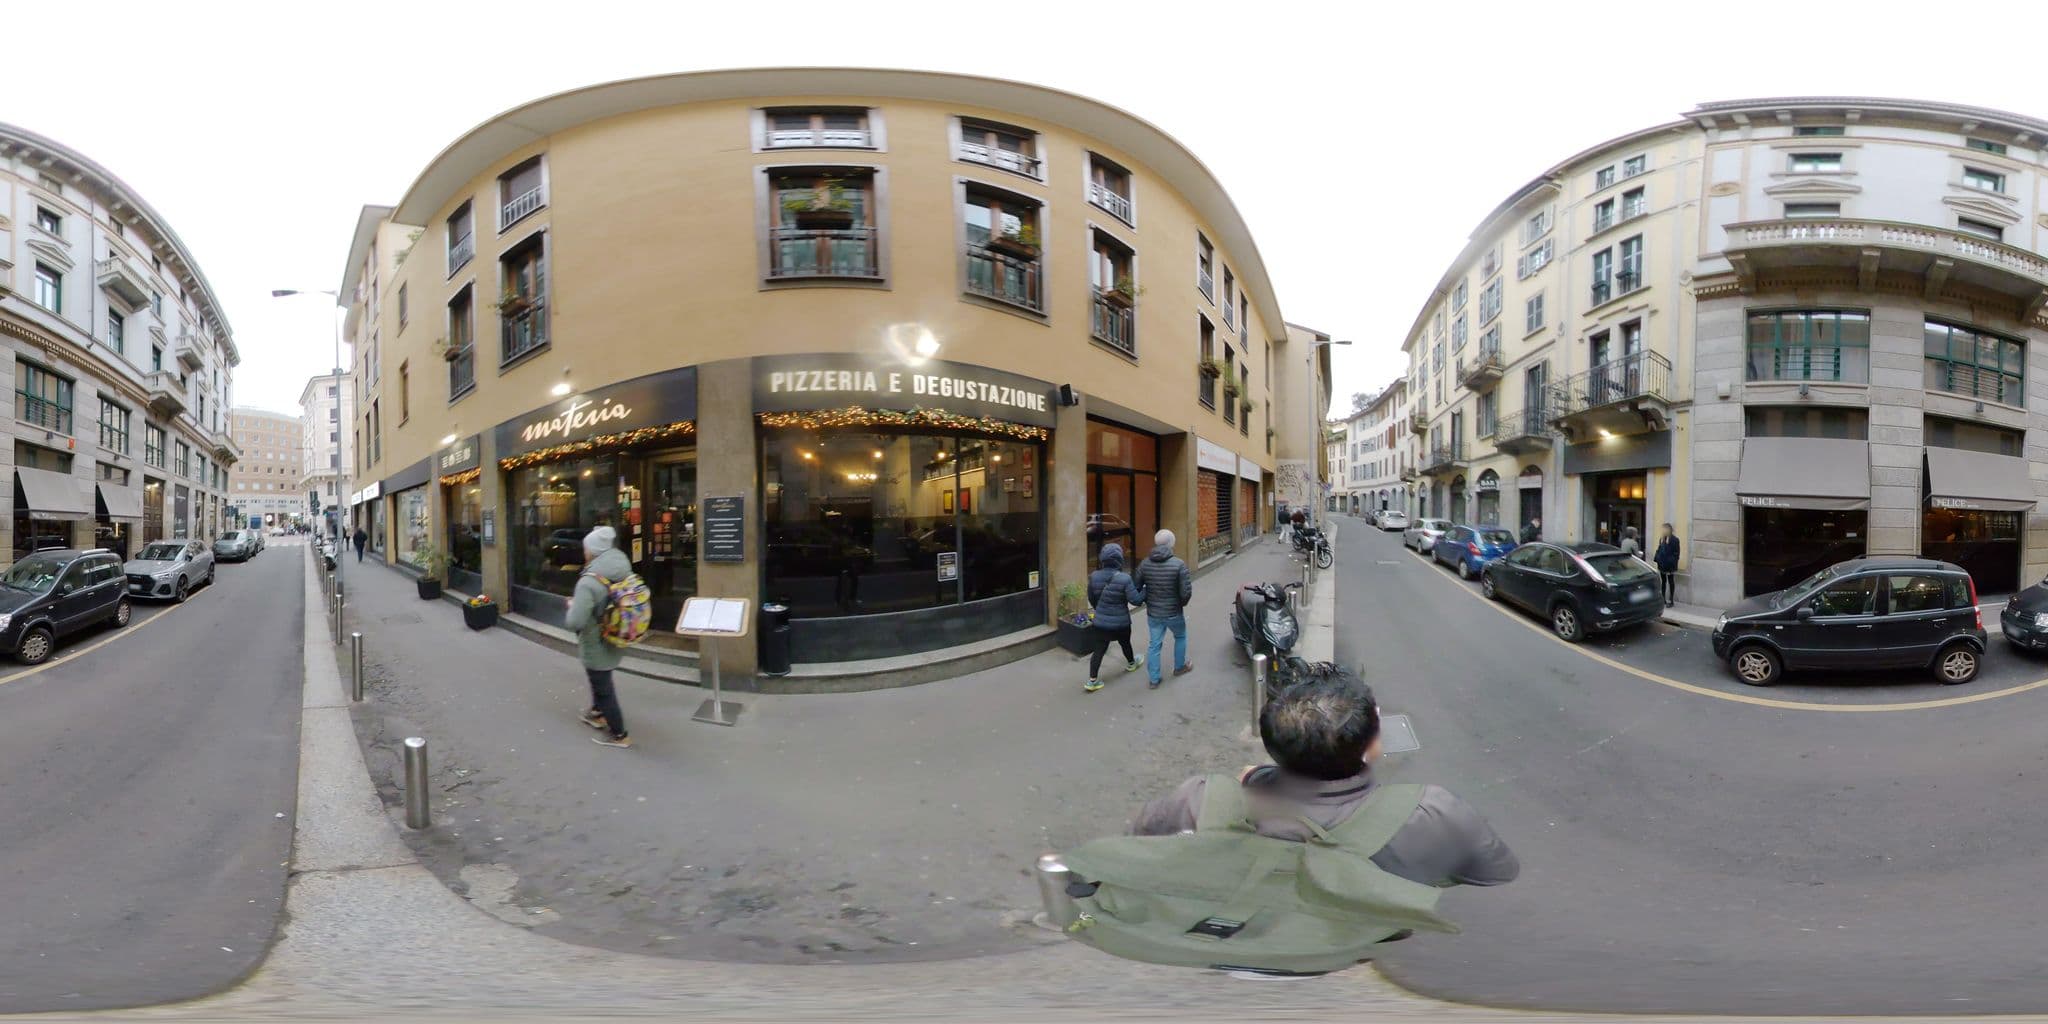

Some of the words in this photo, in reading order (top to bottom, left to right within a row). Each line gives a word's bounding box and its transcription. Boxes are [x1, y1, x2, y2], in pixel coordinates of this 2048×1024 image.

[770, 370, 878, 393] PIZZERIA
[889, 373, 902, 393] E
[913, 374, 1047, 412] DEGUSTAZIONE
[521, 398, 632, 441] materia
[1742, 496, 1775, 506] FELICE
